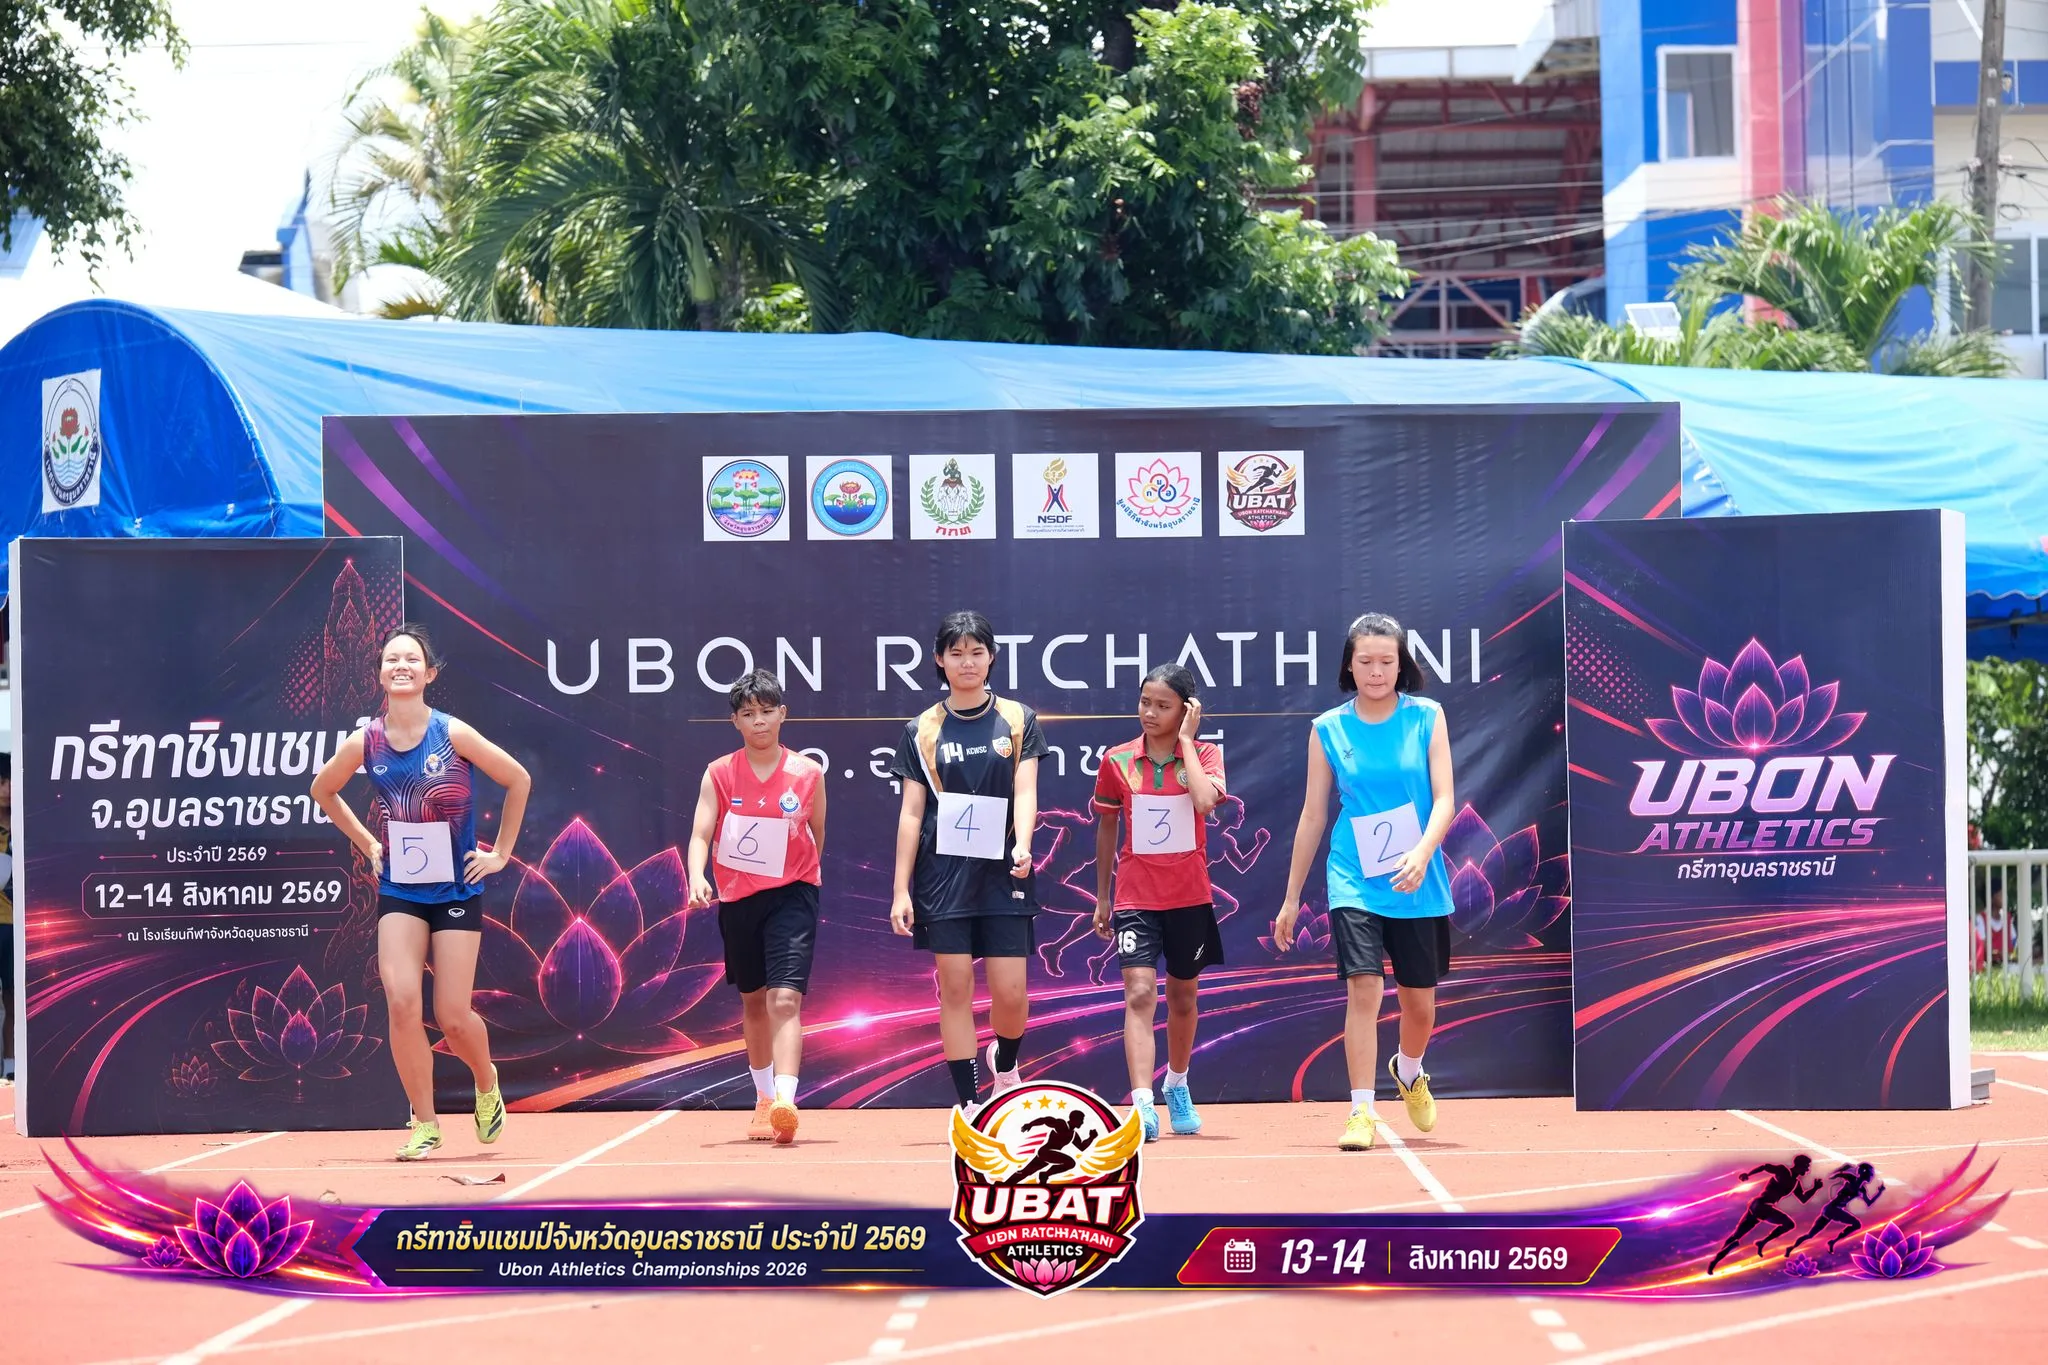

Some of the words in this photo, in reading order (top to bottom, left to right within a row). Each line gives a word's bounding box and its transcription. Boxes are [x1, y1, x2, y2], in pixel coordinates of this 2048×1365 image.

[1233, 494, 1291, 509] UBAT
[1037, 515, 1073, 524] NSDF
[547, 636, 822, 695] UBON
[876, 627, 1480, 691] RTCHATHNI
[940, 742, 964, 764] 14
[1629, 755, 1897, 816] UBON
[737, 822, 759, 857] 6
[954, 803, 981, 842] 4
[1147, 808, 1171, 845] 3
[1634, 818, 1883, 853] ATHLETICS
[166, 846, 222, 863] ประจำปี
[227, 846, 267, 862] 2569
[402, 837, 429, 875] 5
[1373, 821, 1404, 863] 2
[1677, 855, 1837, 884] กรีฑาอุบลราชธานี
[182, 881, 273, 906] สิงหาคม
[281, 880, 342, 904] 2569
[127, 931, 139, 942] ณ
[143, 923, 309, 942] โรงเรียนกีฬาจังหวัดอุบลราชธานี
